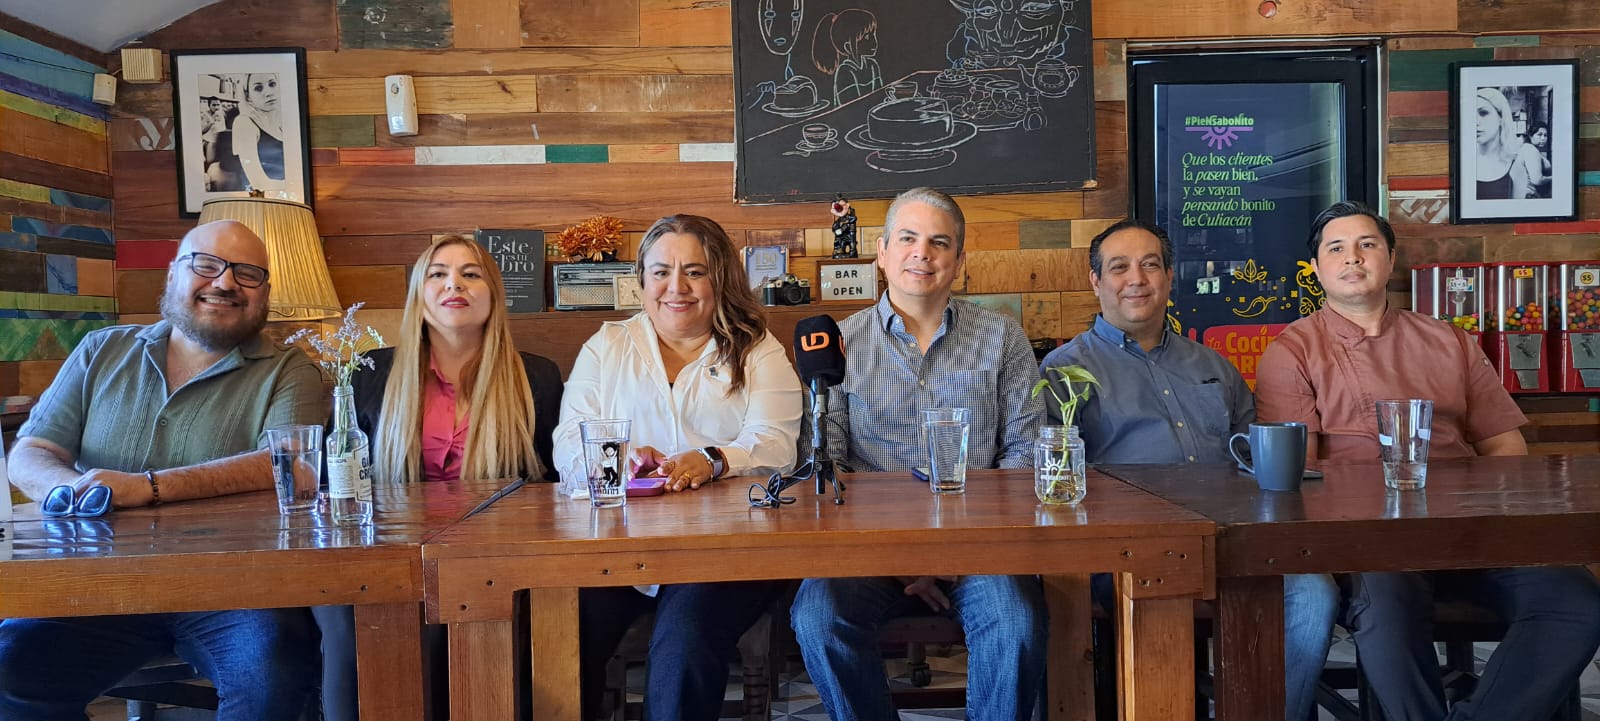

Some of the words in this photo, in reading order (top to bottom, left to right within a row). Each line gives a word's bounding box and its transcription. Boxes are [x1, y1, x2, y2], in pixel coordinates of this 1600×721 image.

[1182, 152, 1208, 168] Que
[1210, 152, 1226, 165] los
[1228, 152, 1273, 166] clientes
[1183, 168, 1193, 181] la
[1194, 170, 1230, 184] pasen
[1183, 186, 1191, 199] y
[1193, 186, 1206, 196] se
[1208, 186, 1241, 199] vayan
[1182, 198, 1239, 215] pensando
[1241, 198, 1276, 211] bonito
[1182, 213, 1197, 226] de
[1198, 213, 1253, 227] Culiacán
[488, 235, 530, 255] Este
[835, 269, 858, 279] BAR
[833, 286, 863, 296] OPEN
